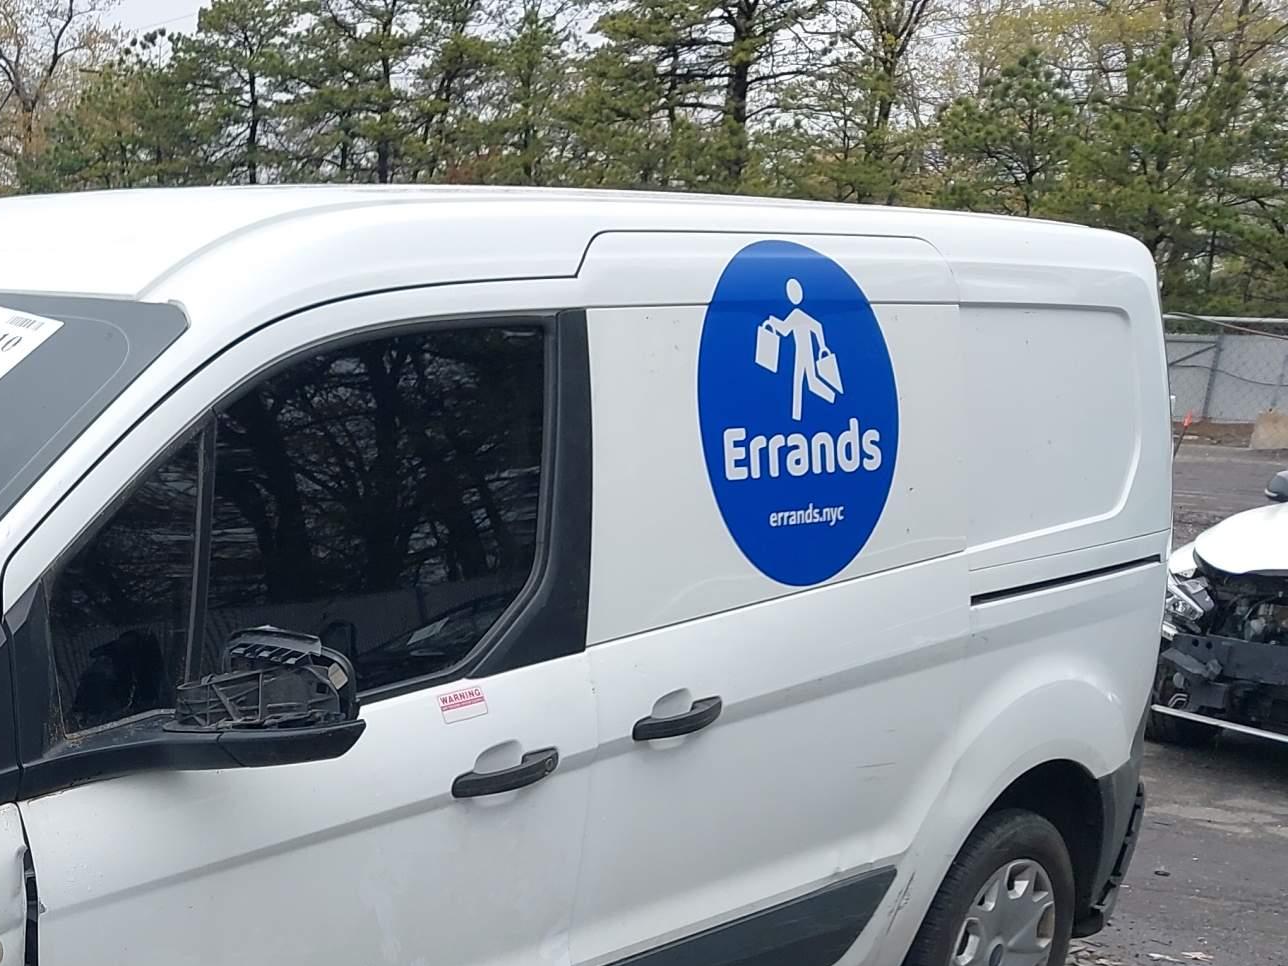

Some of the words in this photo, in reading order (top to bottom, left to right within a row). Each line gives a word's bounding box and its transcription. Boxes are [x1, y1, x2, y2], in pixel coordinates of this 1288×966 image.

[723, 418, 882, 481] Errands
[769, 503, 844, 527] errands.nyc
[440, 688, 481, 705] WARNING
